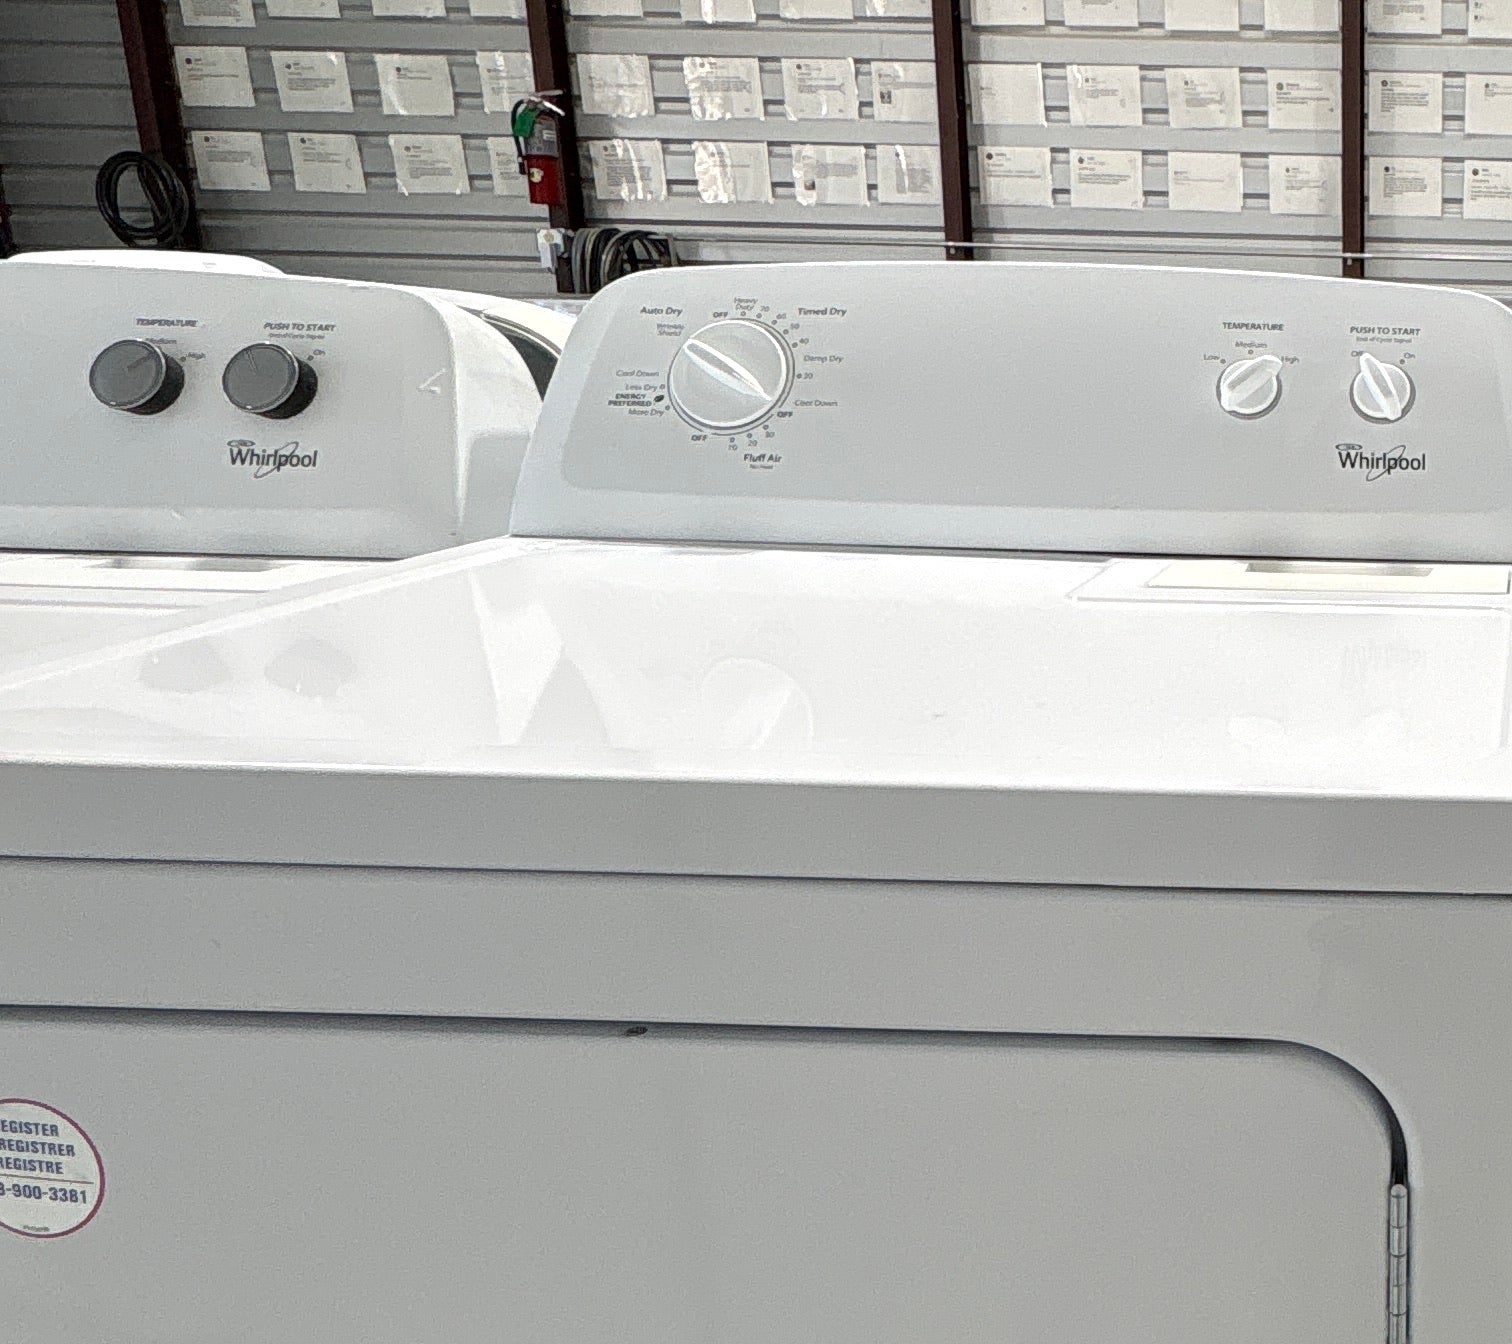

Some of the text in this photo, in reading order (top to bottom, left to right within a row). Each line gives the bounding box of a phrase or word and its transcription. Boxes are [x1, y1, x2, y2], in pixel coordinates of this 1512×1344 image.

[640, 307, 683, 316] Auto Dry
[798, 307, 847, 316] Timed Dry
[136, 318, 198, 327] TEMPERATURE
[264, 322, 336, 332] PUSH TO START
[1222, 321, 1284, 331] TEMPERATURE
[1350, 326, 1421, 336] PUSH TO START
[643, 384, 657, 392] Dry
[229, 446, 319, 474] Whirlpool
[743, 454, 782, 463] Fluff Air
[1338, 450, 1426, 475] Whirlpool
[0, 1119, 59, 1137] EGISTER
[0, 1182, 87, 1204] 8-900-3381
